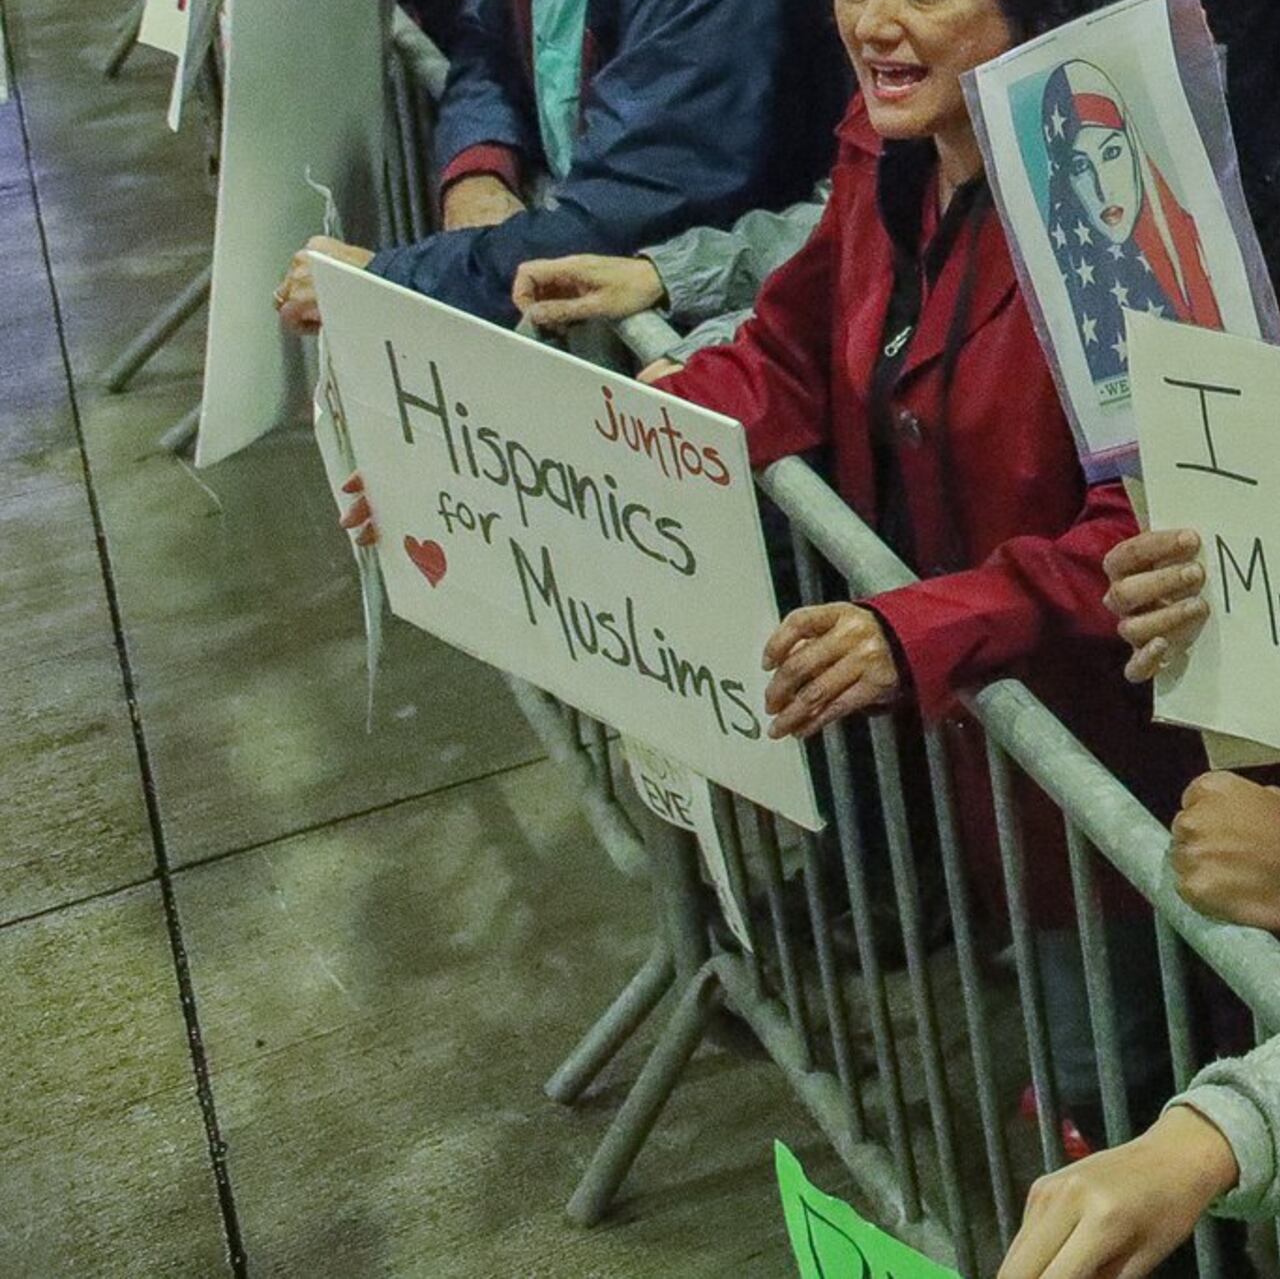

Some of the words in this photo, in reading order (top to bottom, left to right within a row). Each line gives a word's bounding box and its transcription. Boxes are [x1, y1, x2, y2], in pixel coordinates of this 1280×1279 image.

[385, 339, 697, 577] Hispanics
[594, 386, 731, 486] juntos
[1164, 377, 1258, 486] I
[437, 492, 501, 544] for
